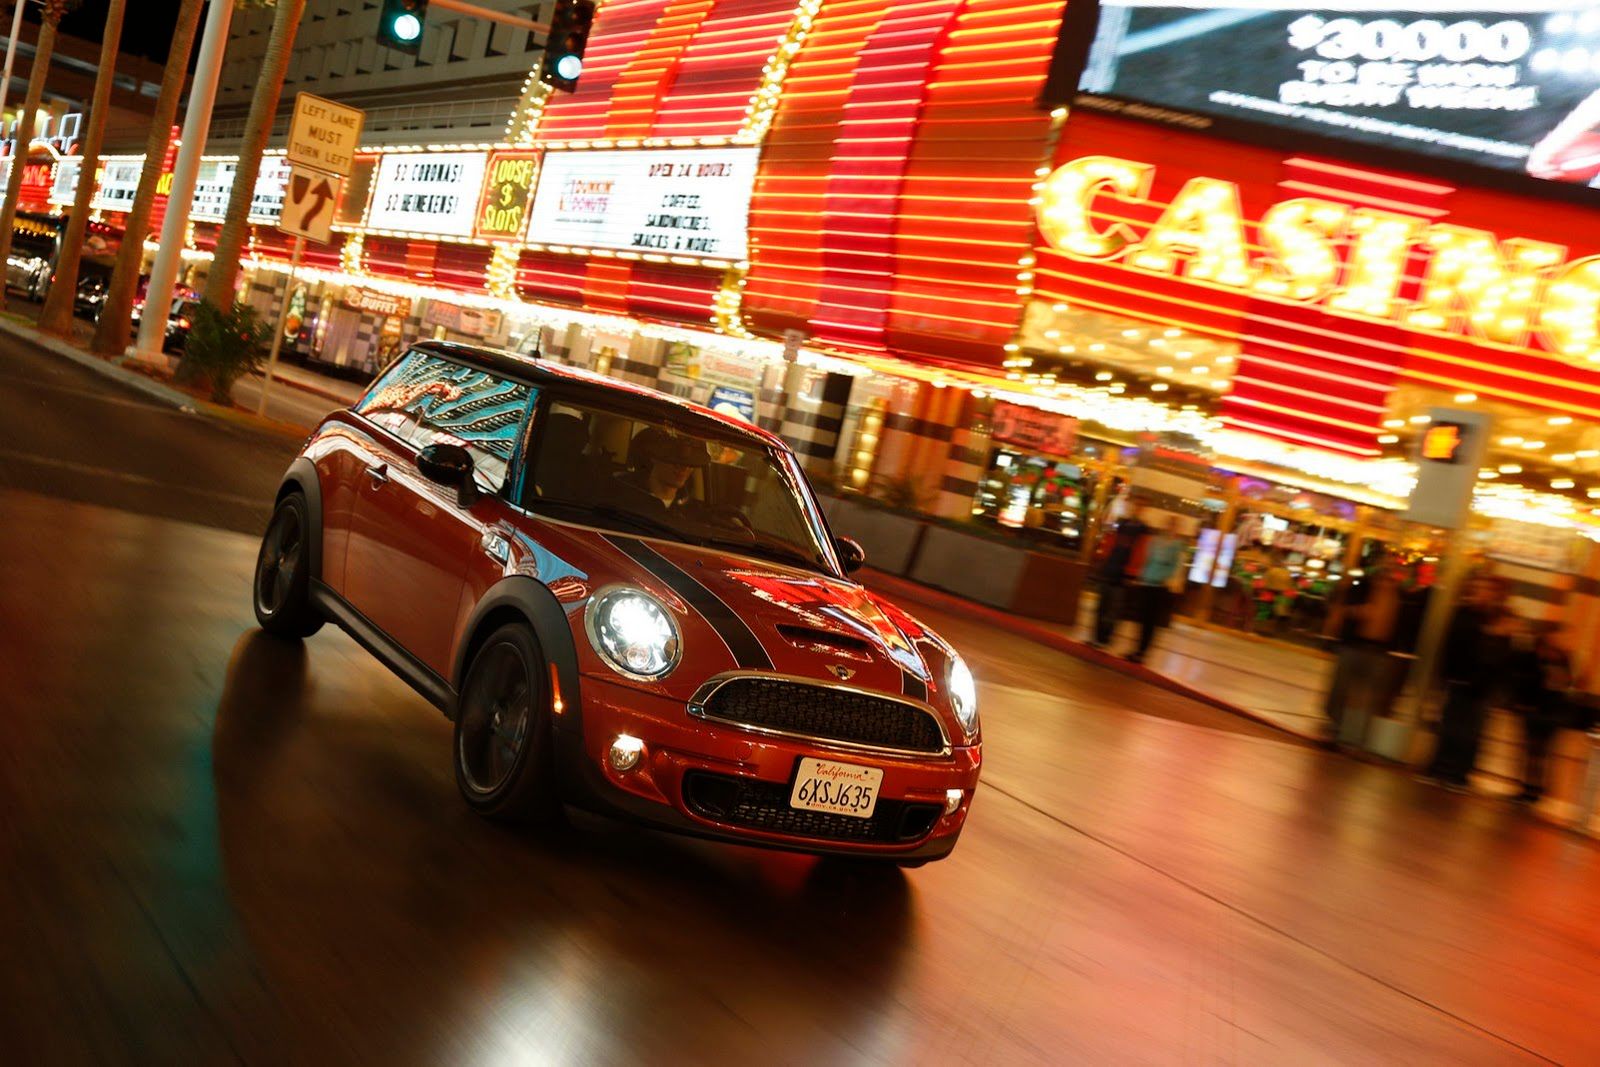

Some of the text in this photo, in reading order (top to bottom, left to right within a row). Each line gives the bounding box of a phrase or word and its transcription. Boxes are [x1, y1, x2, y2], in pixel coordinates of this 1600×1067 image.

[1297, 59, 1356, 83] TO
[302, 104, 356, 129] LEFT LANE
[308, 124, 342, 146] MUST
[294, 142, 349, 166] TURN LEFT
[394, 164, 464, 183] $2 CORONAS!
[491, 159, 534, 189] LOOSE
[648, 163, 673, 177] OPEN
[696, 163, 733, 177] HOURS
[385, 194, 399, 211] $2
[499, 183, 513, 206] $
[483, 204, 521, 232] SLOTS
[1034, 155, 1600, 372] CASINO
[360, 296, 399, 314] BUFFET
[816, 763, 865, 781] California
[798, 778, 873, 810] 6XSJ635
